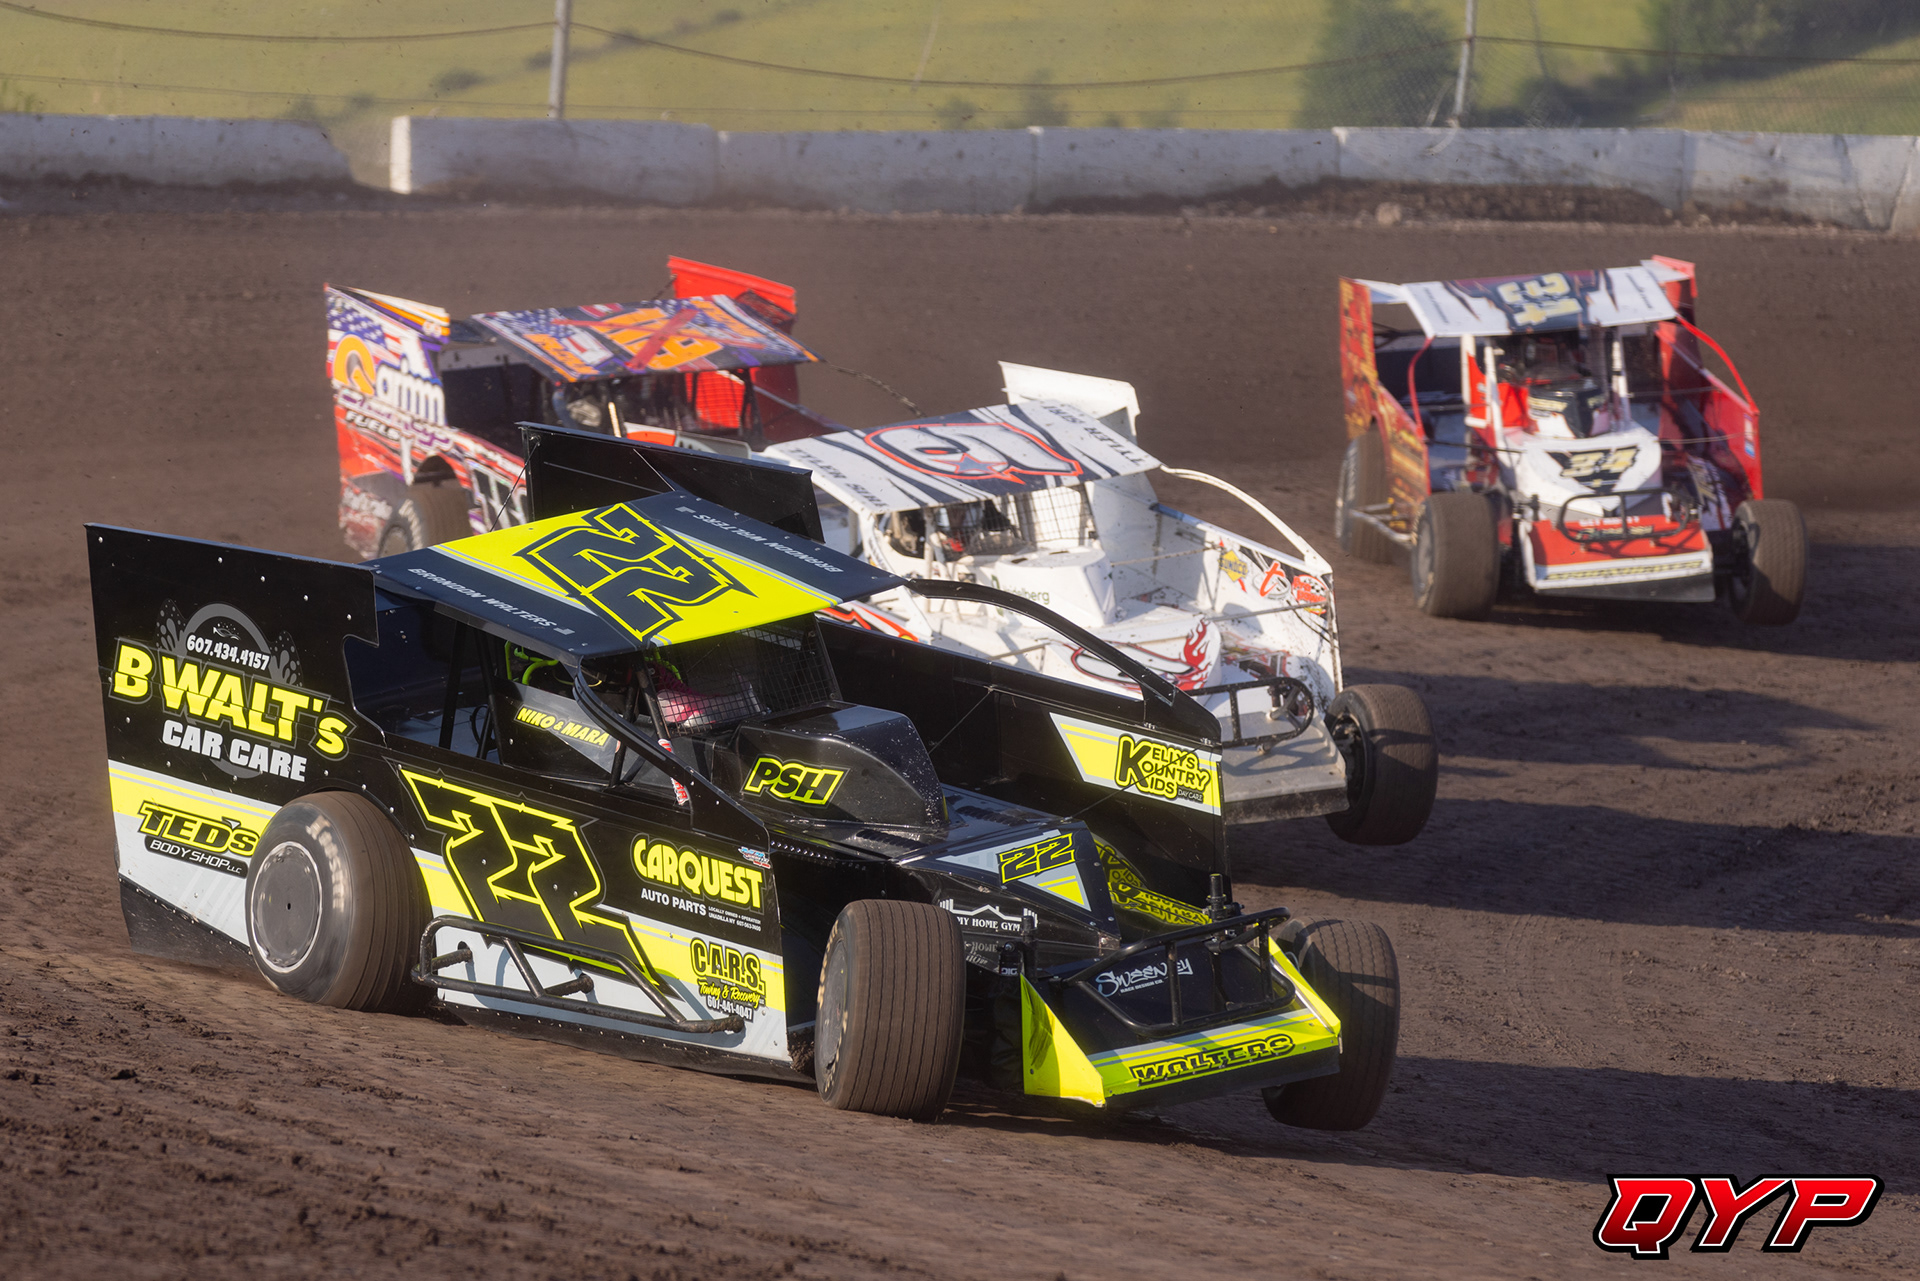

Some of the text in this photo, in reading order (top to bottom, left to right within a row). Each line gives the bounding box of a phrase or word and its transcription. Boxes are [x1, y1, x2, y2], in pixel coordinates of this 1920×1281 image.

[693, 514, 844, 573] BRANDON WALTERS
[526, 503, 734, 642] 22
[407, 568, 558, 627] BRANDON WALTERS
[113, 644, 153, 698] B
[186, 635, 270, 671] 607.434.4157
[162, 719, 308, 782] CAR CARE
[517, 707, 610, 747] NIKO & MARA
[745, 758, 844, 804] PSH
[150, 839, 191, 858] BODY
[189, 851, 230, 872] SHOP
[633, 838, 763, 909] CARQUEST
[999, 832, 1076, 884] 22
[641, 888, 707, 916] AUTO PARTS
[972, 919, 998, 929] HOME
[1001, 922, 1020, 932] GYM
[698, 981, 761, 1008] Towing & Recovery
